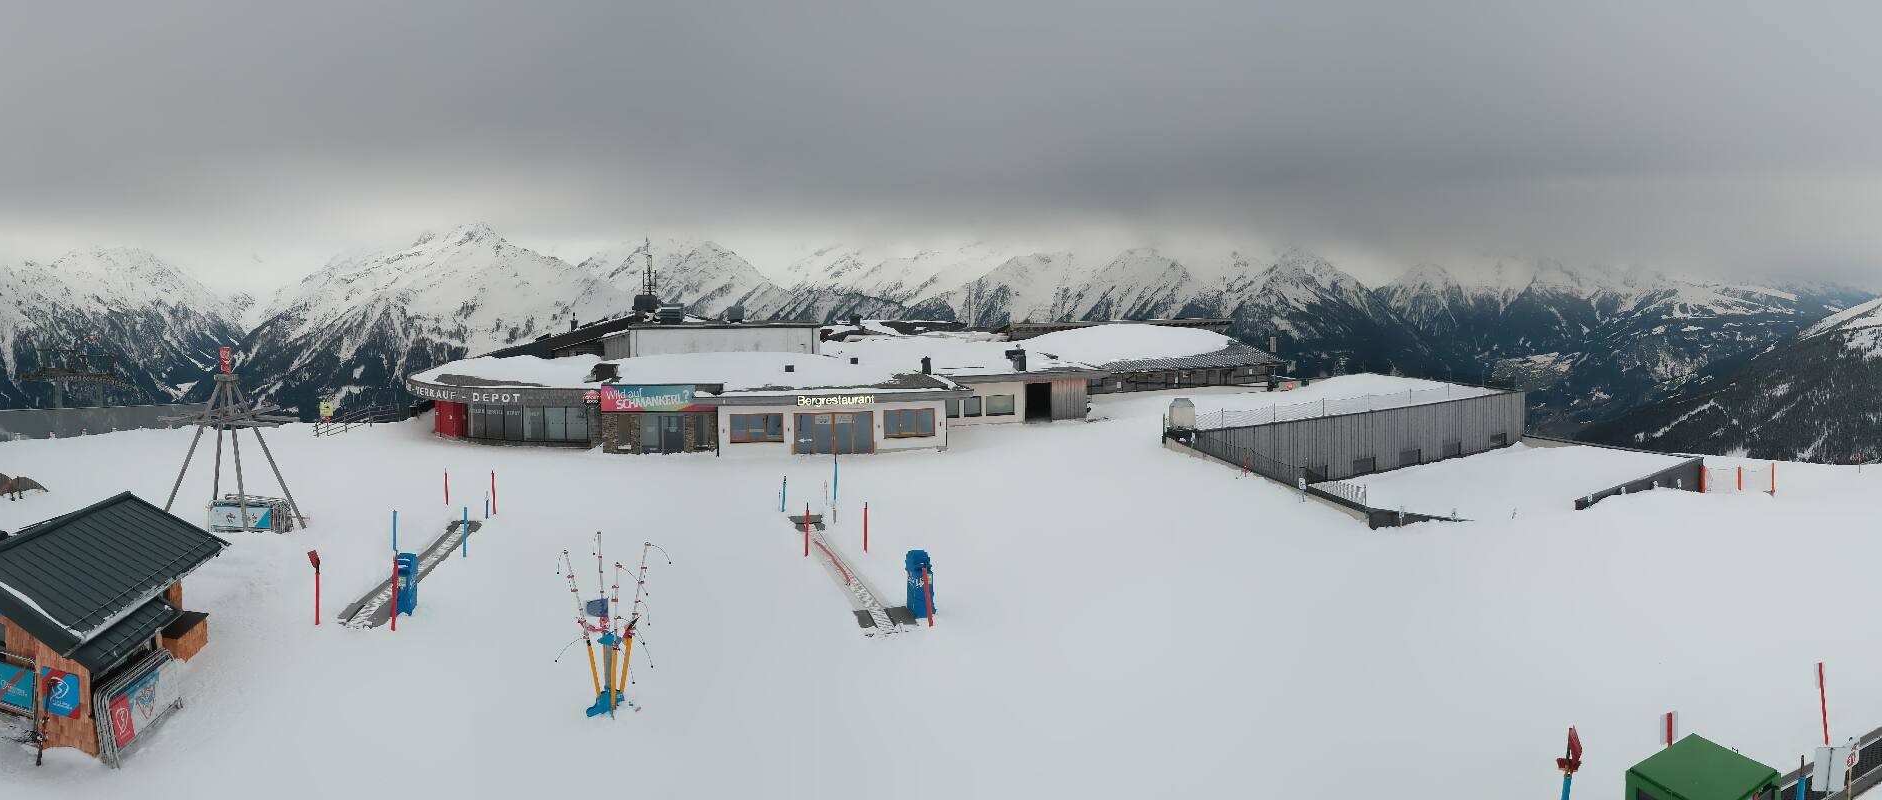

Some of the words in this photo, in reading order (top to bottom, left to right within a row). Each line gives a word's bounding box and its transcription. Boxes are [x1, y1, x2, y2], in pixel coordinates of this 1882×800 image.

[415, 385, 456, 400] VERKAUF
[472, 393, 521, 403] DEPOT
[606, 388, 626, 400] Wild
[628, 388, 644, 398] auf
[797, 394, 875, 407] Bergrestaurant
